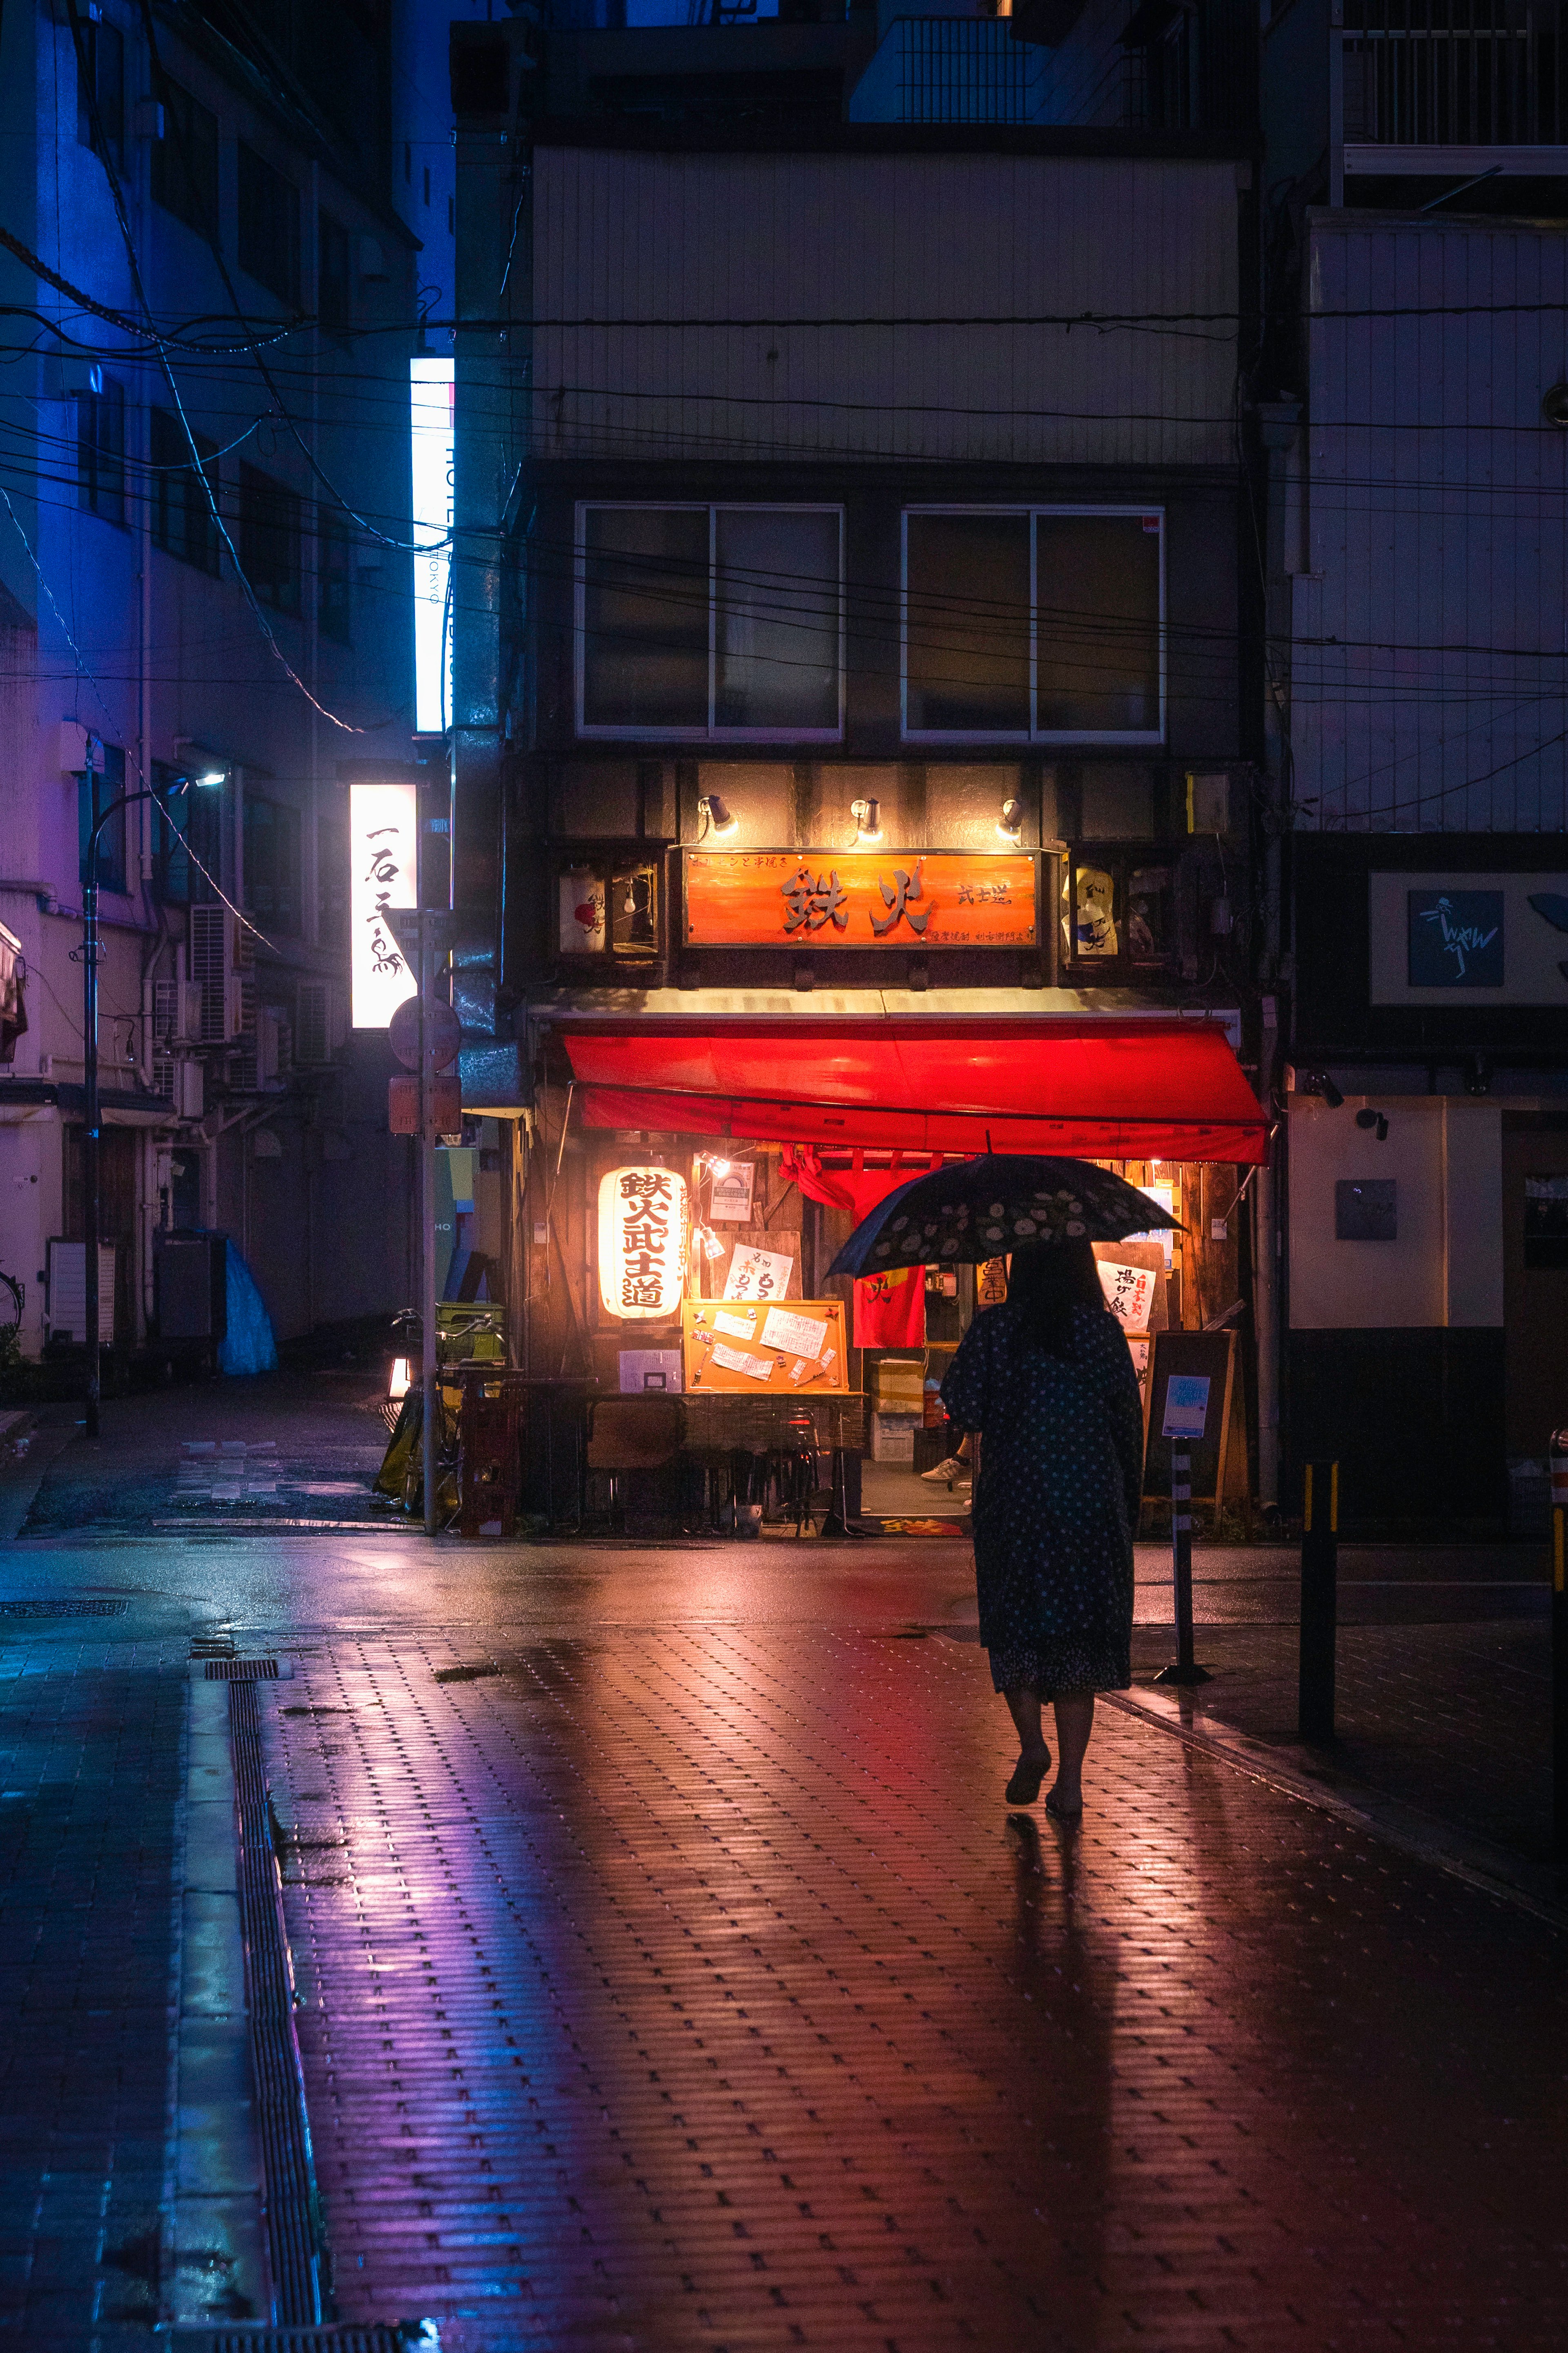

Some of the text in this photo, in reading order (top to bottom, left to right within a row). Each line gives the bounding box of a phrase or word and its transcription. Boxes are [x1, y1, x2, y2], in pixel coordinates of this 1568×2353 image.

[619, 1173, 673, 1308] 鉄火武士道
[757, 1273, 774, 1300] もつ
[1131, 1274, 1146, 1316] 自家製
